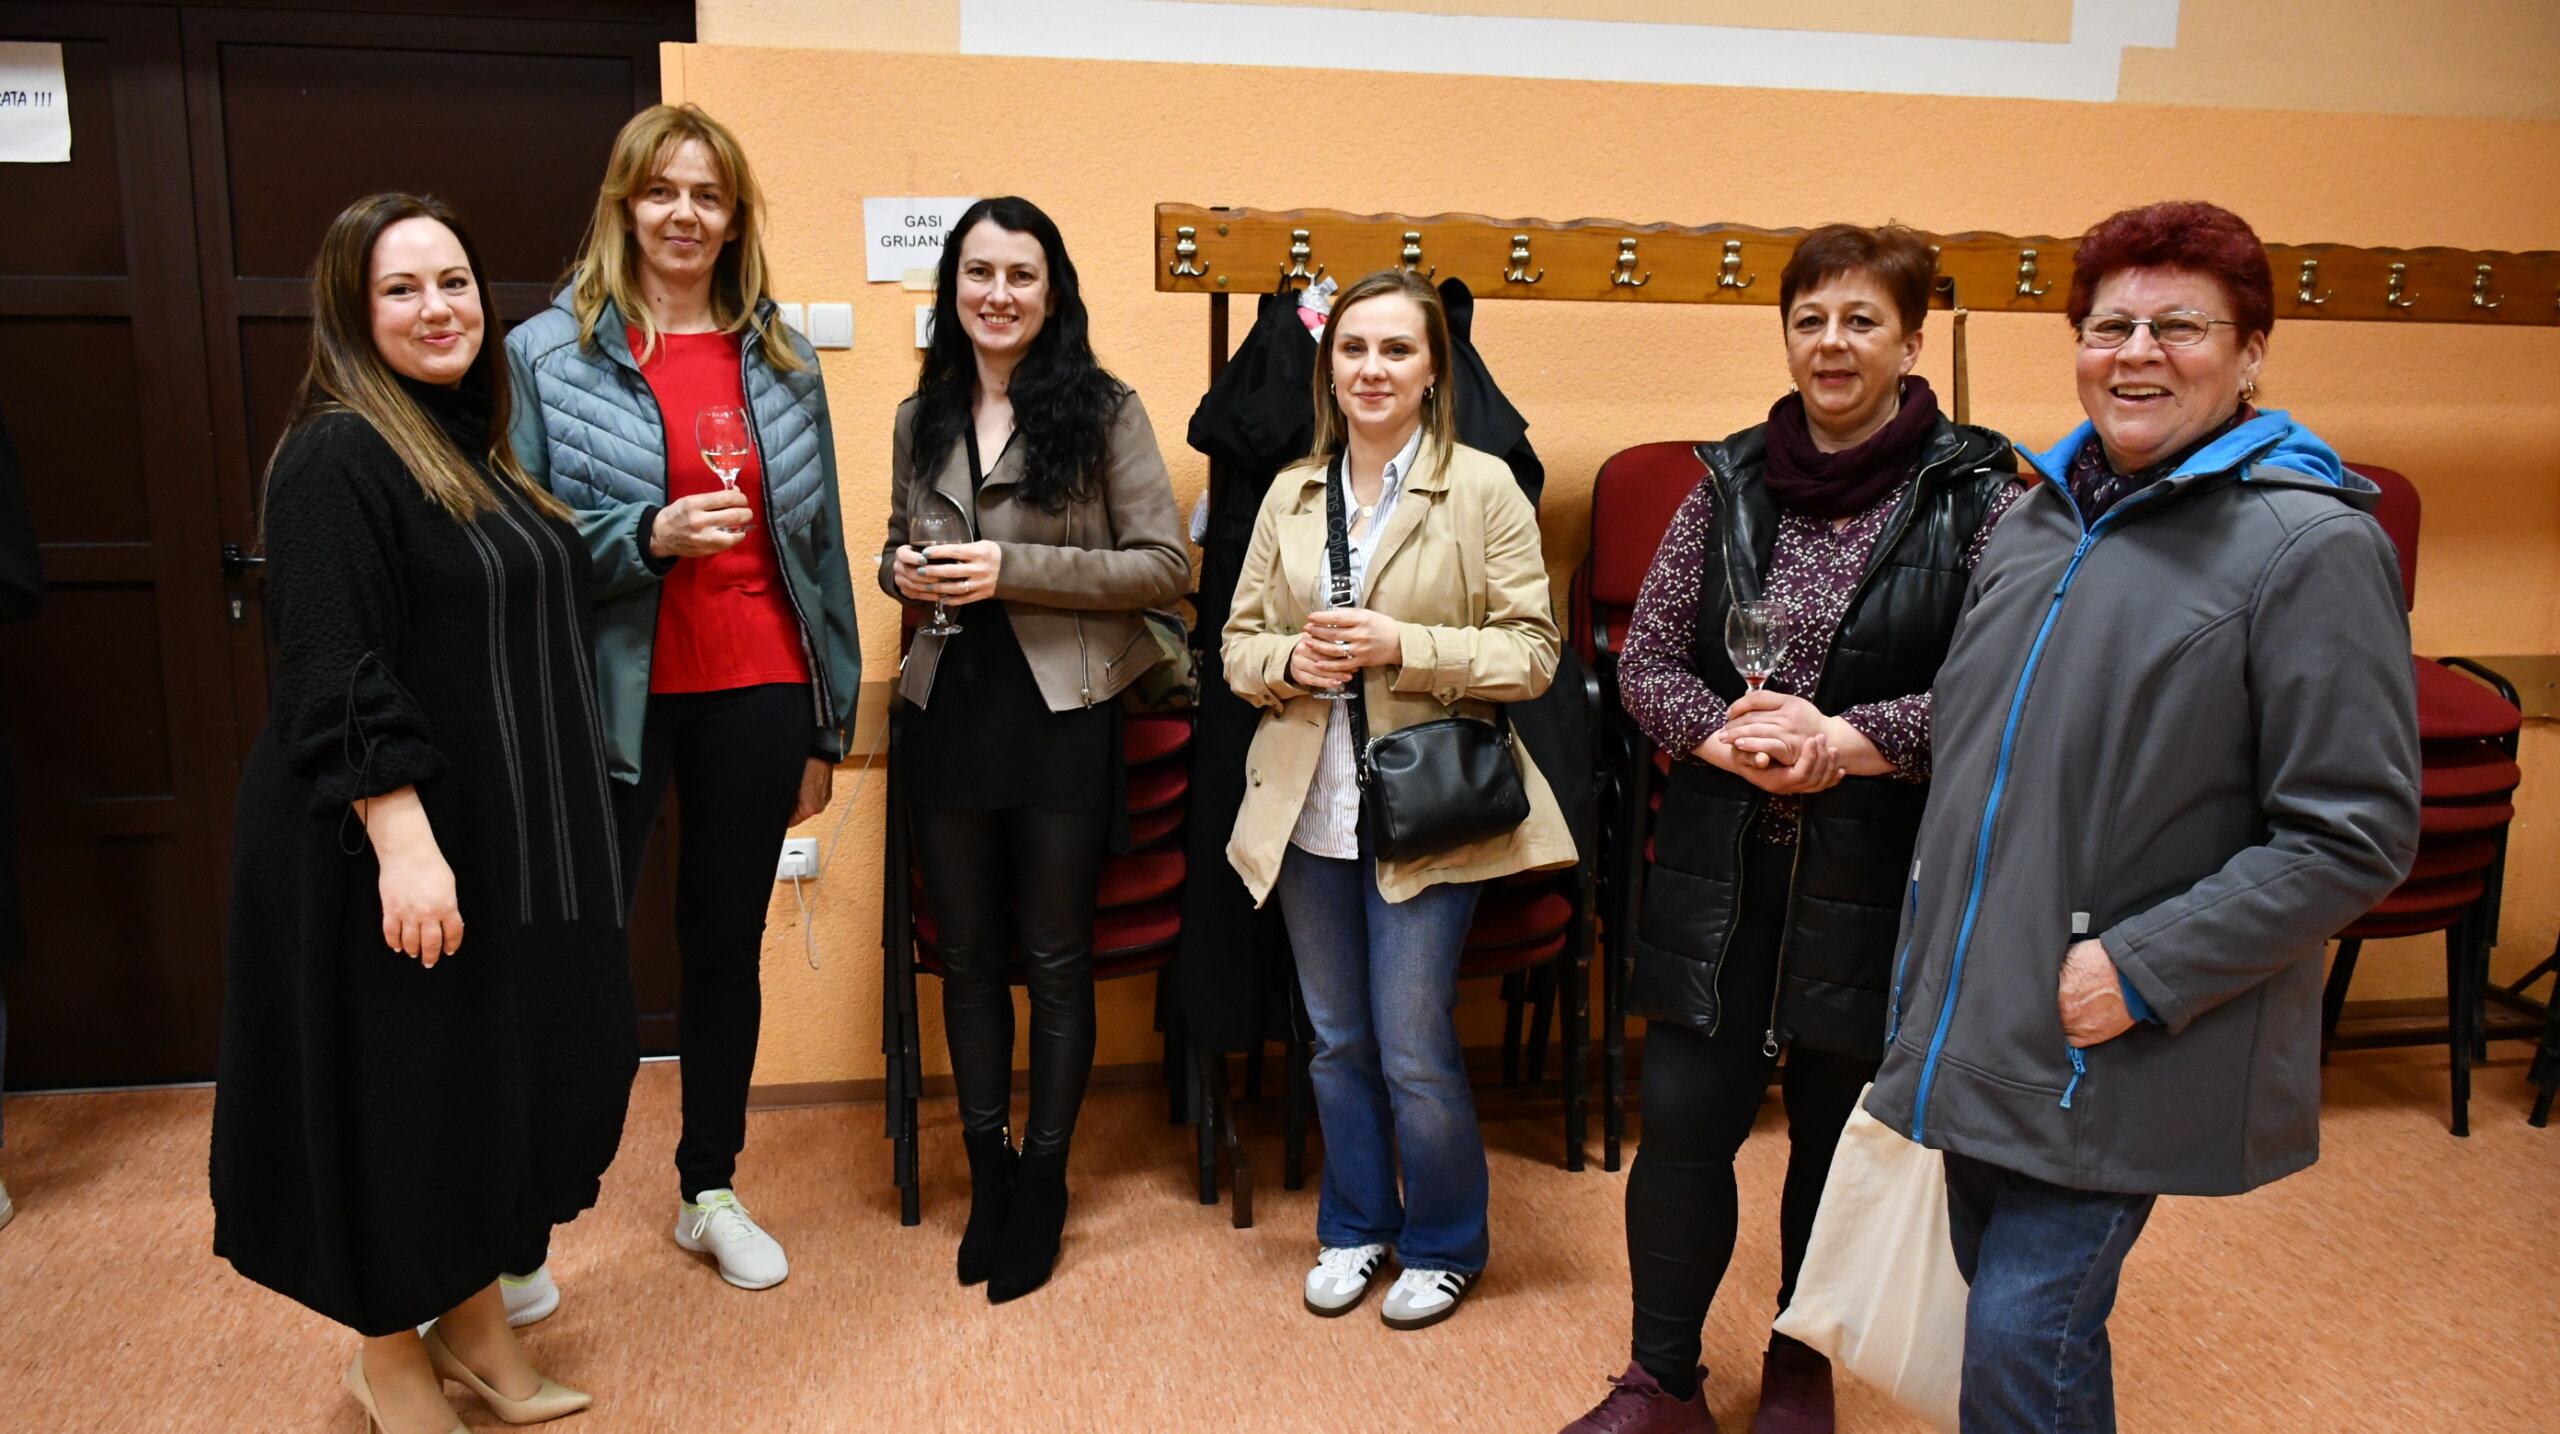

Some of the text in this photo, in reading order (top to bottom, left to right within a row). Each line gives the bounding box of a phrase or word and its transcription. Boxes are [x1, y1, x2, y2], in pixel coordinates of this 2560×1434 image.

[0, 91, 52, 107] ATA !!!
[904, 215, 942, 227] GASI
[1329, 516, 1348, 570] Calvin
